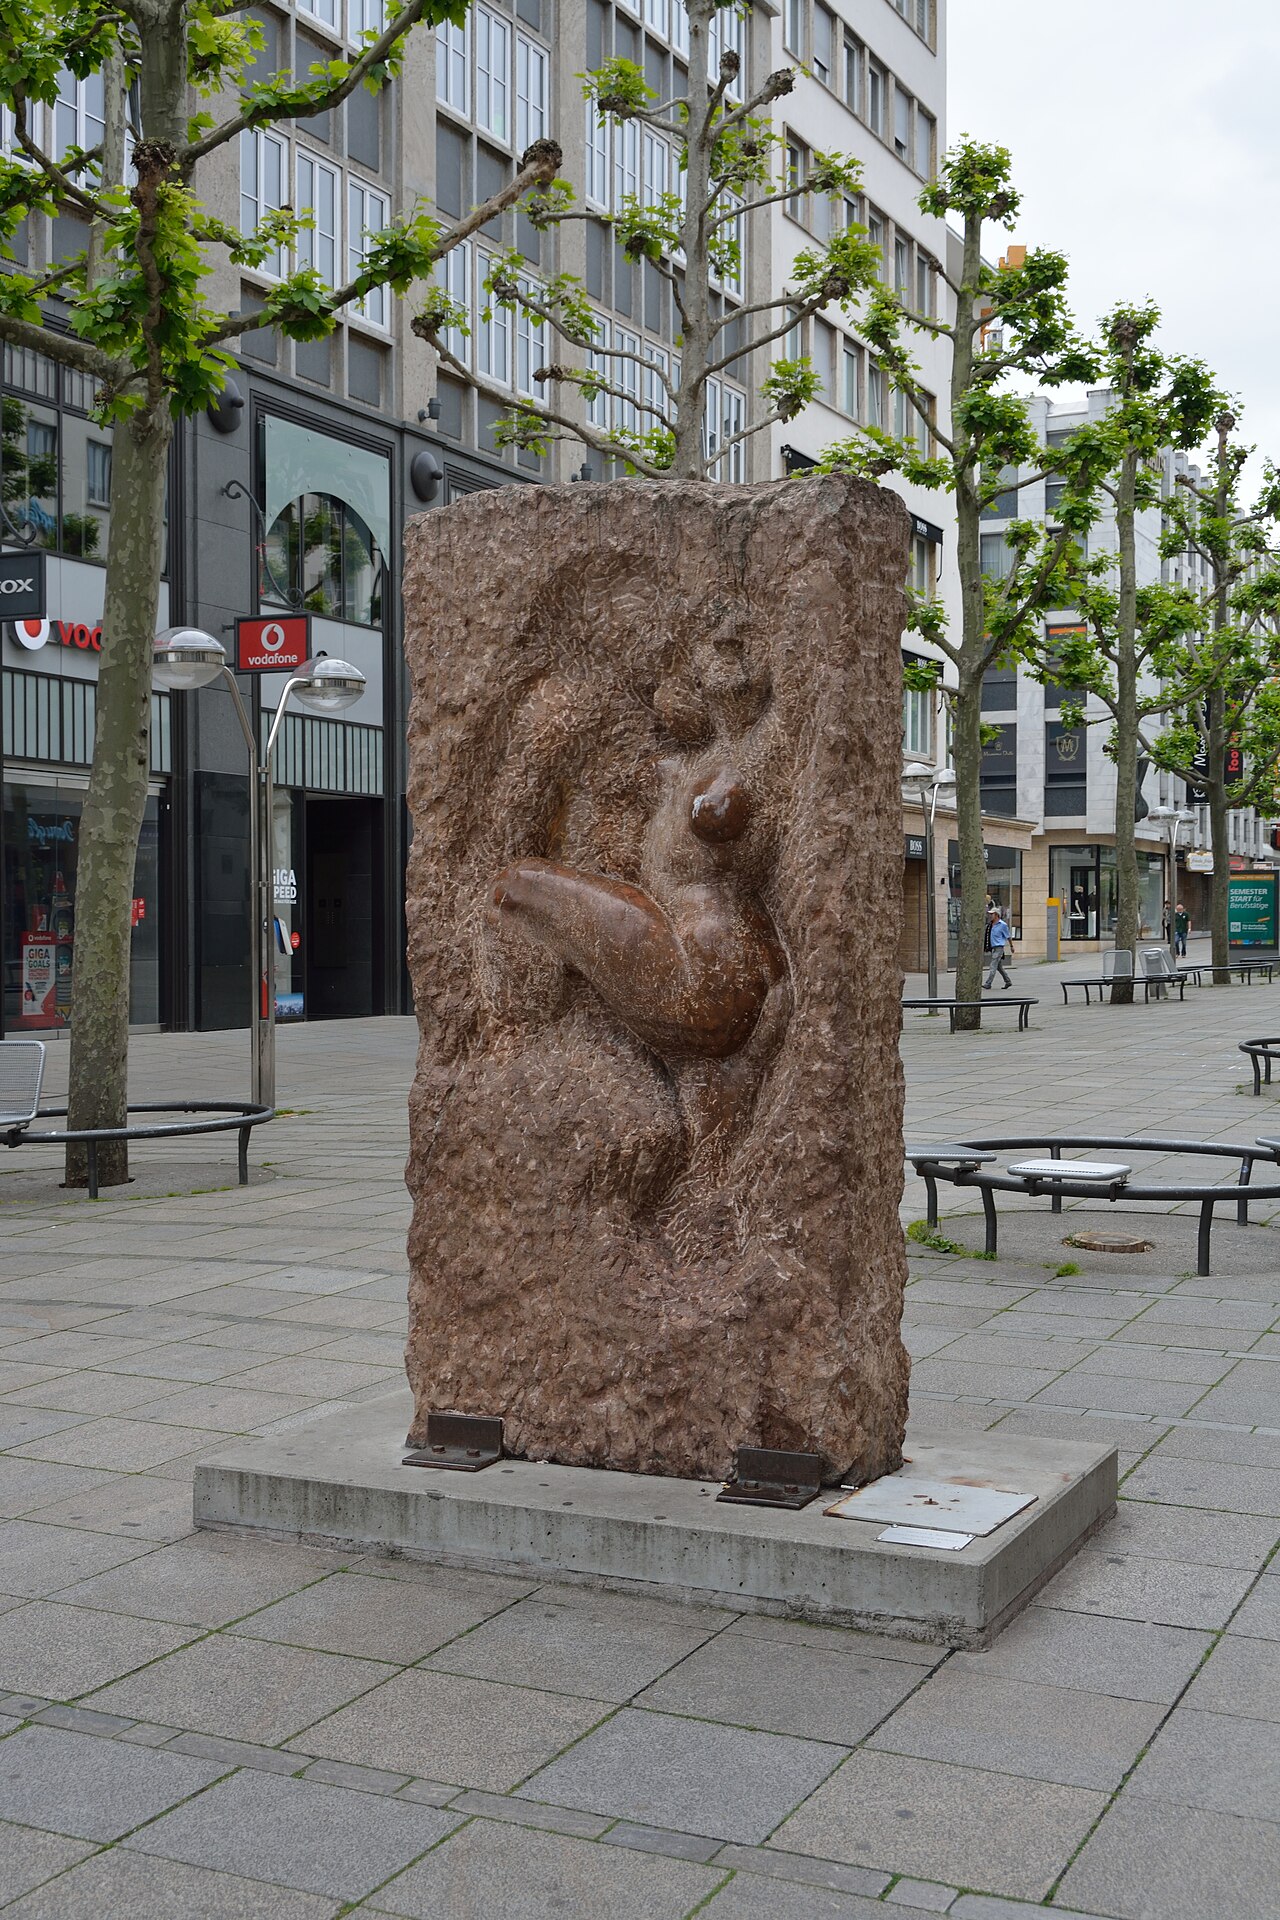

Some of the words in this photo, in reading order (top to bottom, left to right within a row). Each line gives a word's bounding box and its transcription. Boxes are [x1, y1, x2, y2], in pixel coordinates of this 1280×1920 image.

[0, 578, 34, 594] OX
[247, 653, 298, 665] vodafone
[910, 839, 922, 852] BOSS
[273, 885, 297, 899] PEED
[28, 948, 50, 959] GIGA
[28, 960, 50, 968] GOALS
